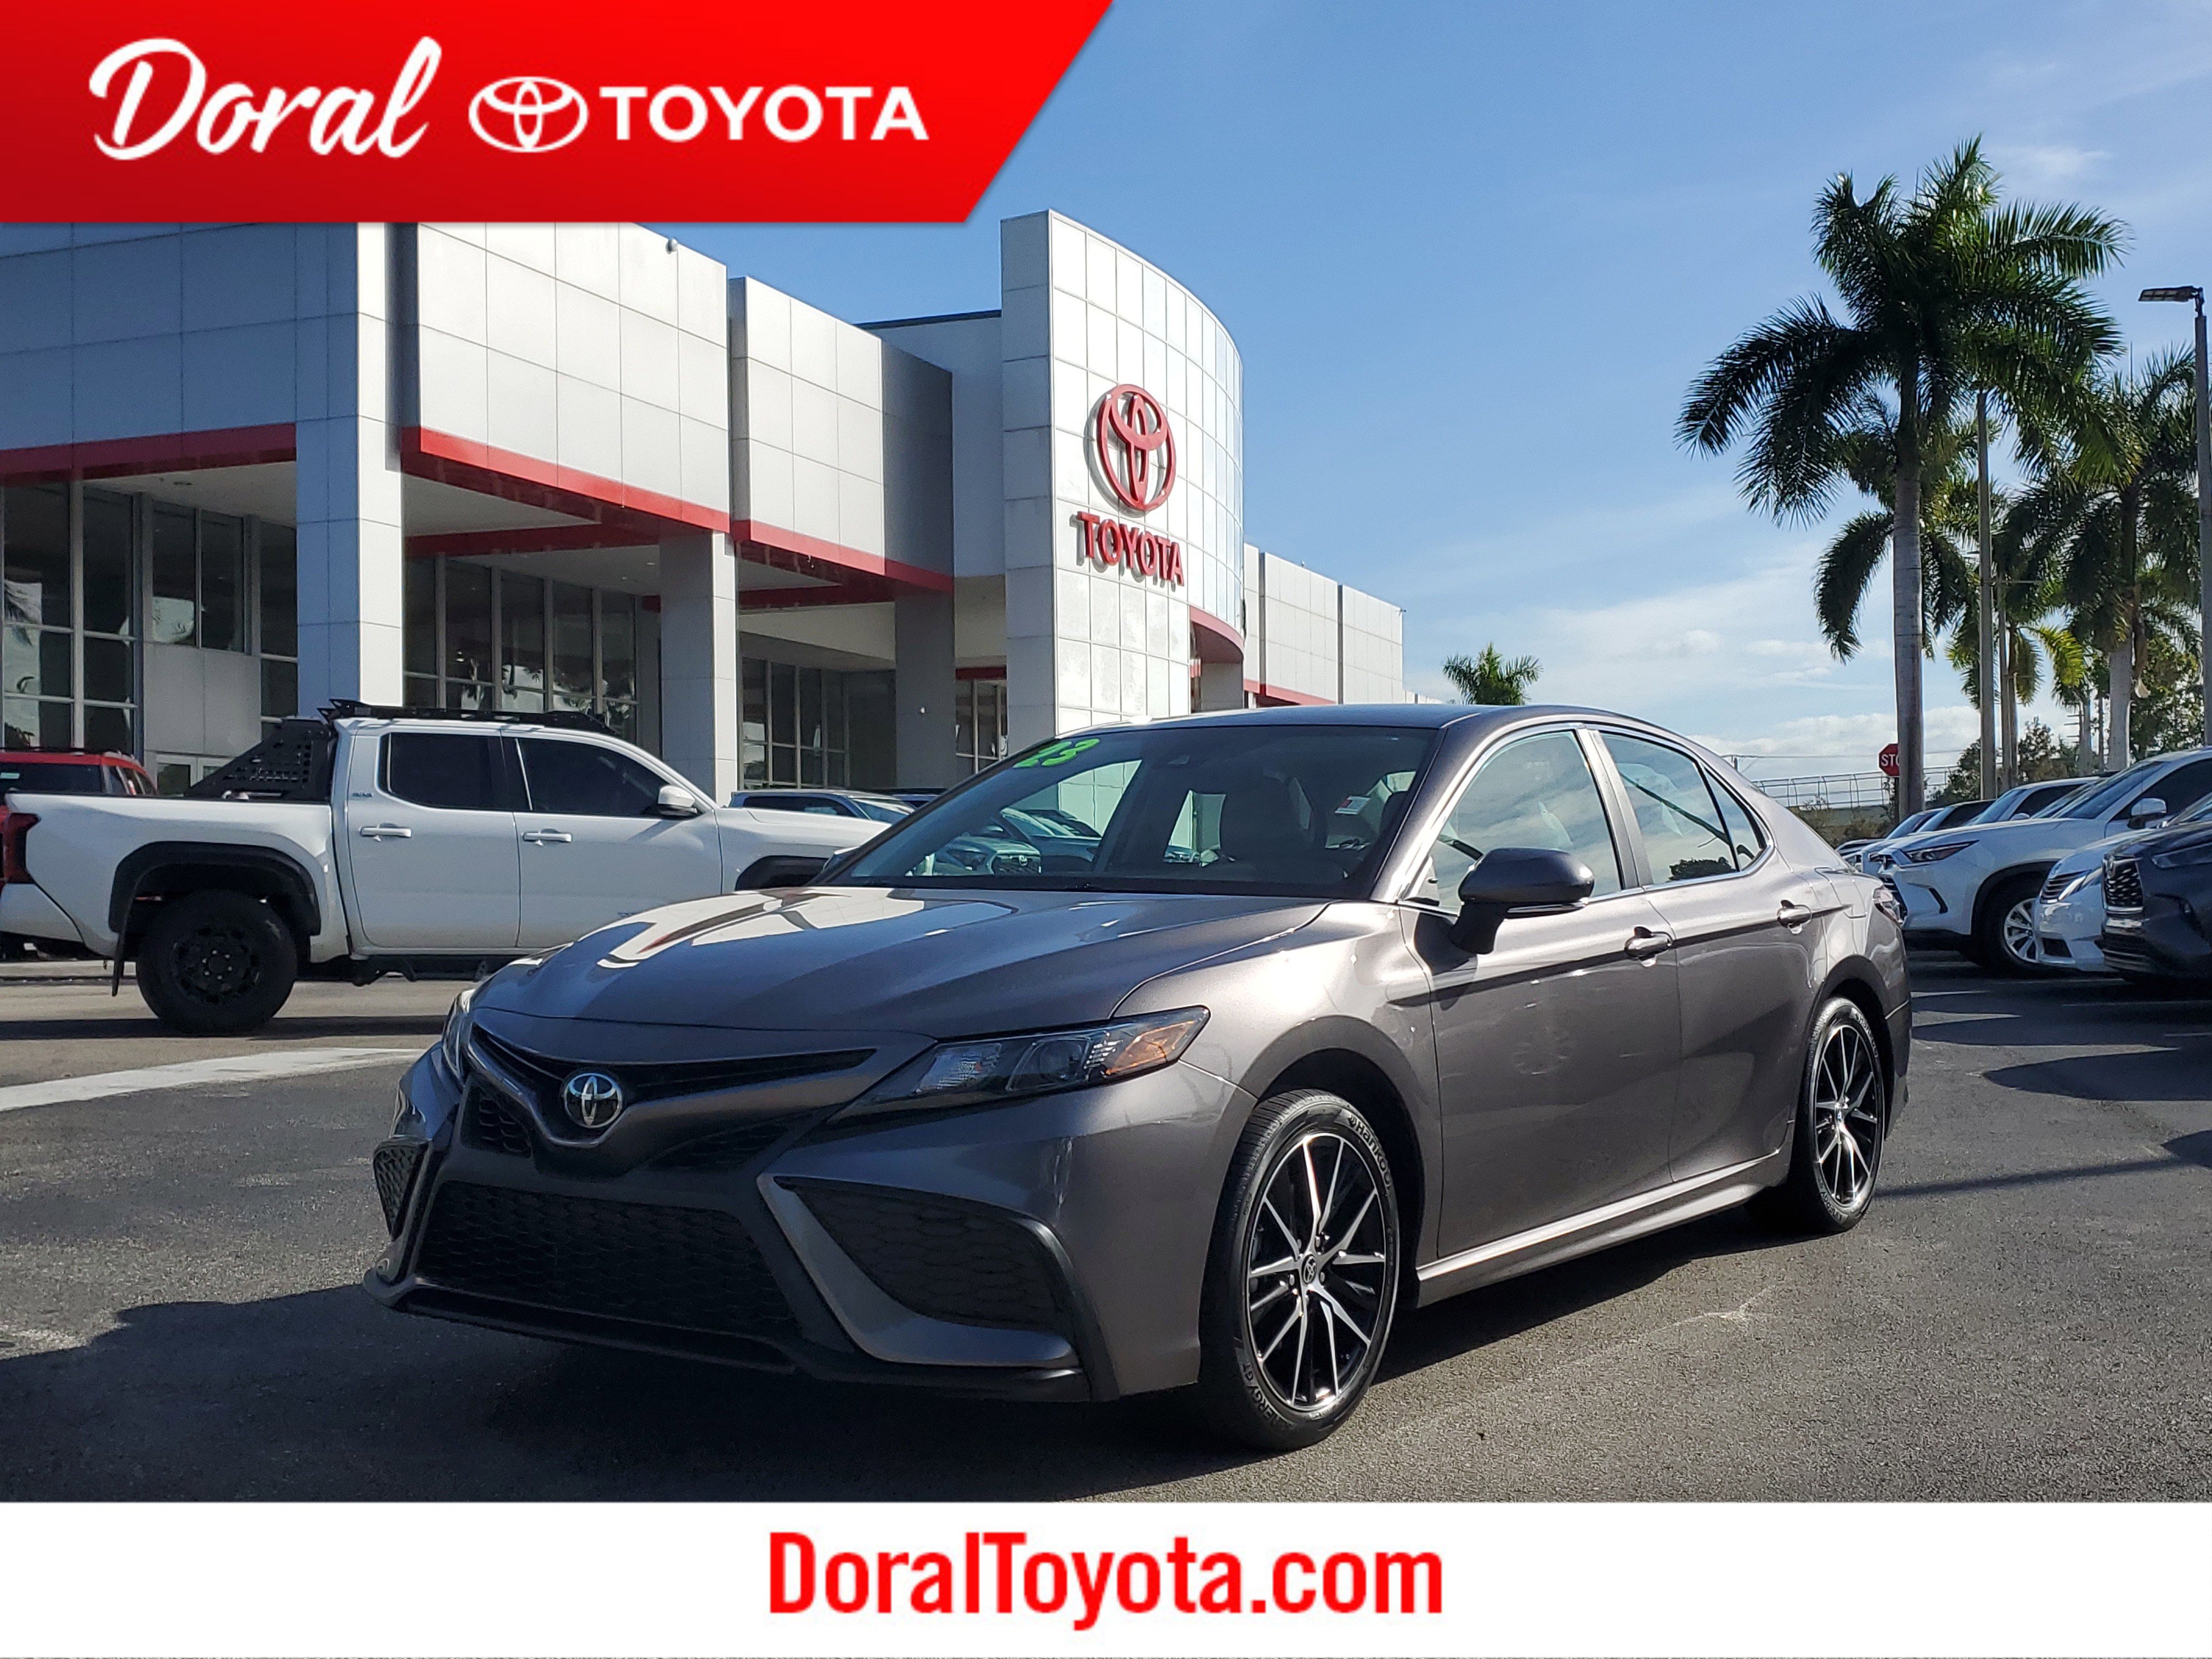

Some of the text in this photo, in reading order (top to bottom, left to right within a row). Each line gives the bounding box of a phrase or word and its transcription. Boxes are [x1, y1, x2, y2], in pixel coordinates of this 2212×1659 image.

[1077, 511, 1184, 586] TOYOTA
[1013, 738, 1099, 768] 23
[1881, 754, 1899, 766] STO
